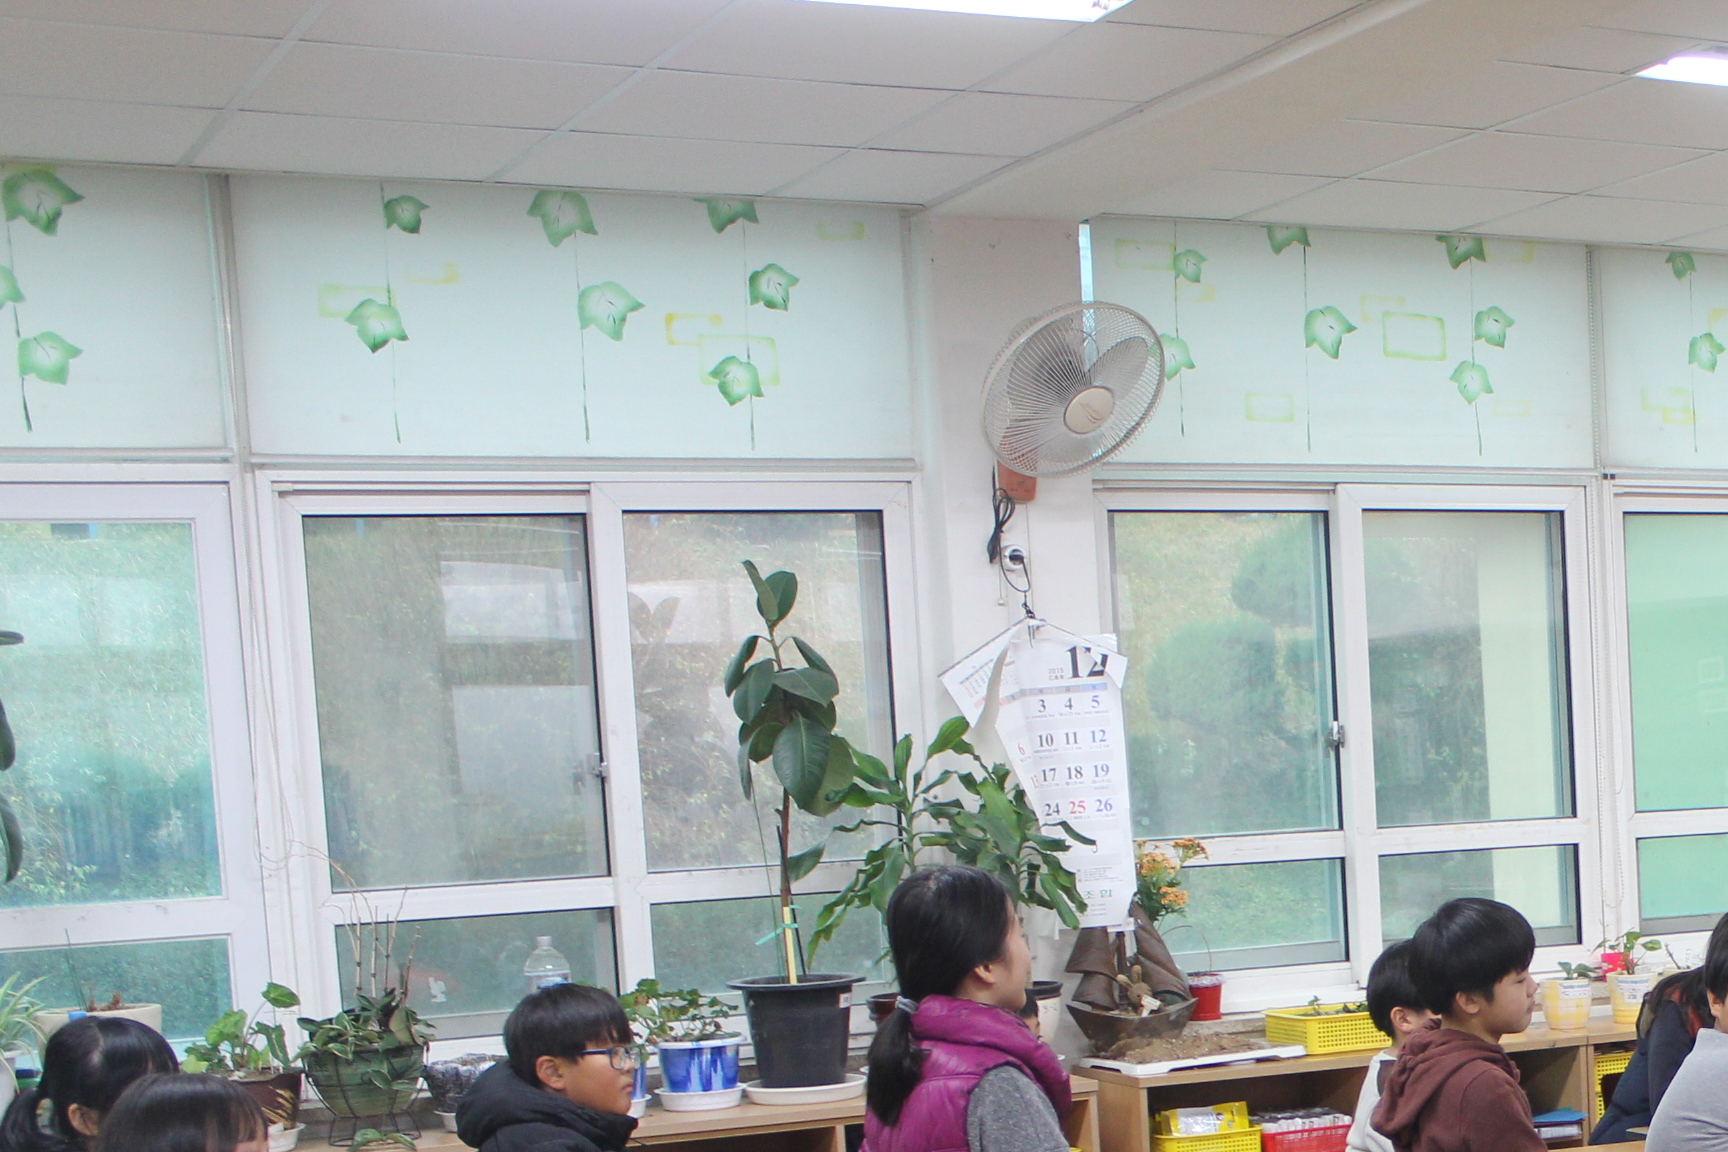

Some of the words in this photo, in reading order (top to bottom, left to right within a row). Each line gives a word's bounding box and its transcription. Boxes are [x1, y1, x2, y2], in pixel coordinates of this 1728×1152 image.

[1038, 699, 1046, 713] 3
[1064, 697, 1073, 710] 4
[1091, 695, 1100, 709] 5
[1038, 733, 1055, 748] 10
[1064, 731, 1079, 745] 11
[1090, 729, 1107, 743] 12
[1041, 768, 1057, 782] 17
[1066, 766, 1083, 780] 18
[1093, 764, 1109, 778] 19
[1044, 803, 1061, 817] 24
[1069, 800, 1086, 815] 25
[1095, 798, 1113, 813] 26
